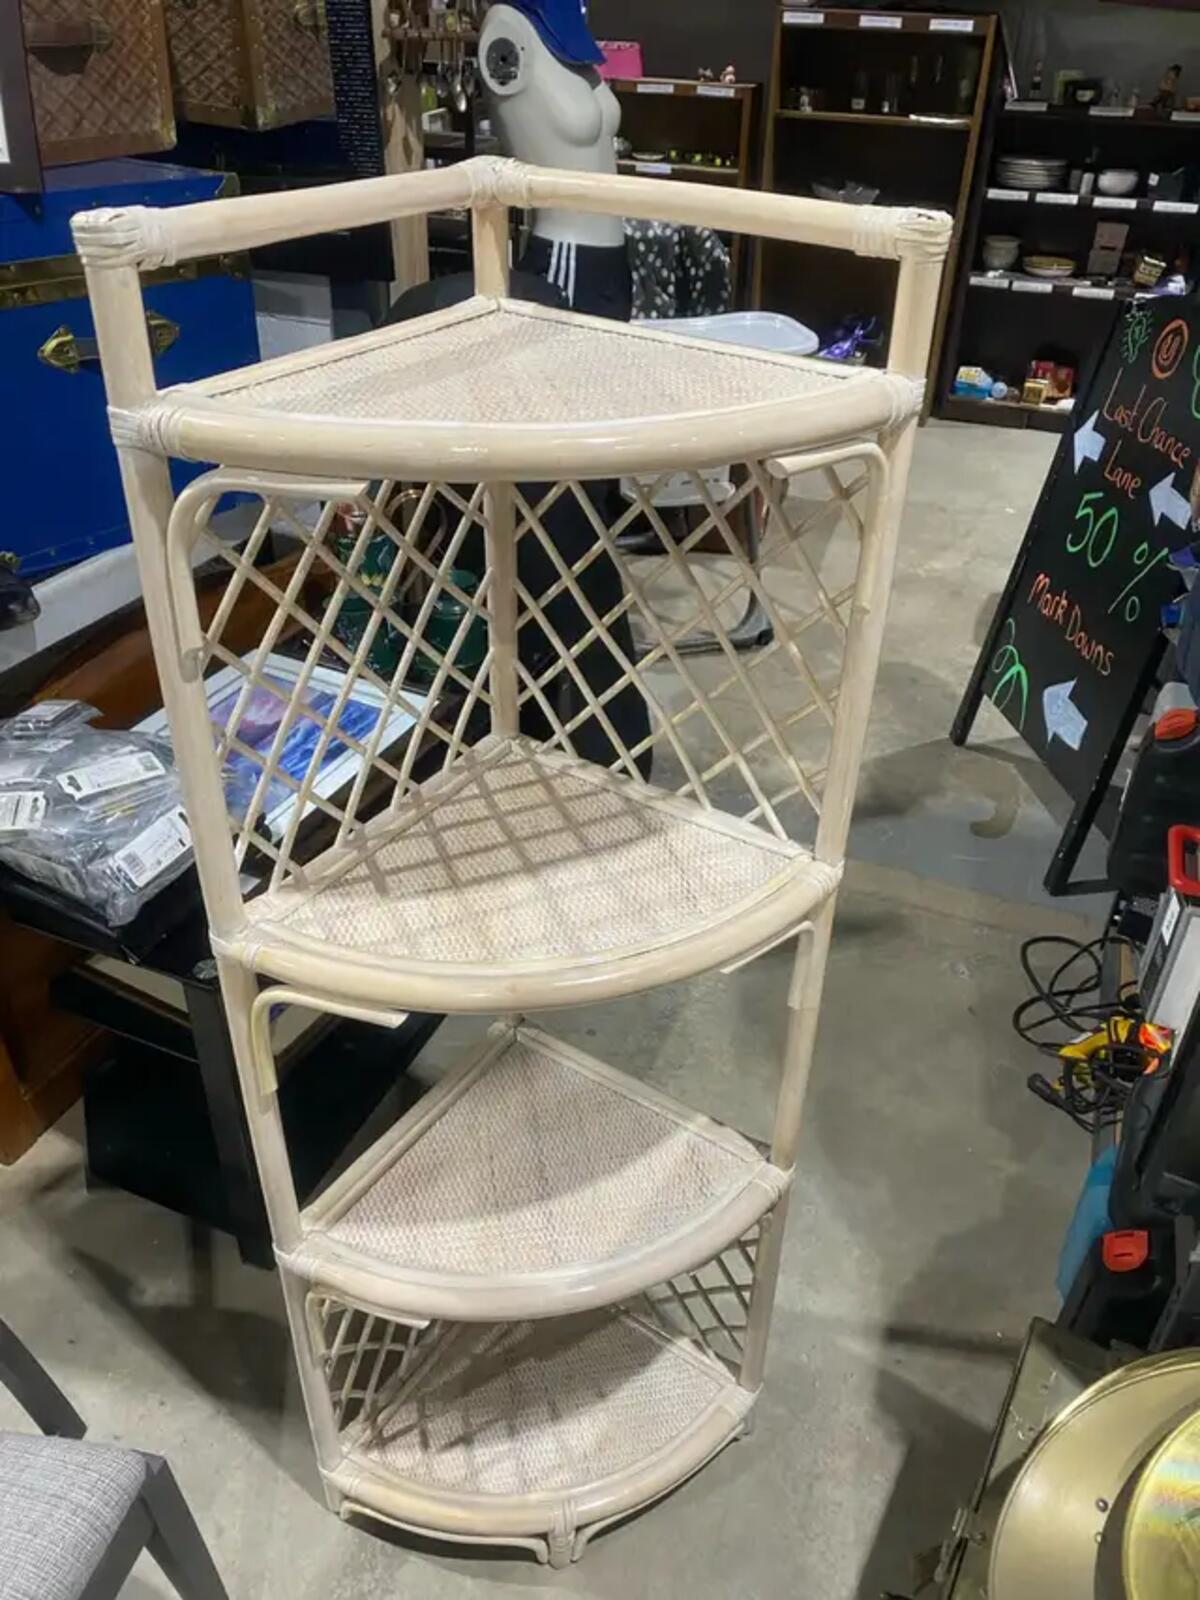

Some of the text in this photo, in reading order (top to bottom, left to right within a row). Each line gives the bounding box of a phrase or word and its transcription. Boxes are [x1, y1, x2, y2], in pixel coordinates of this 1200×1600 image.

[1103, 367, 1191, 469] Last Chance
[1104, 439, 1141, 499] Lane
[1066, 492, 1169, 622] 50 %
[1027, 572, 1114, 677] Mark Downs
